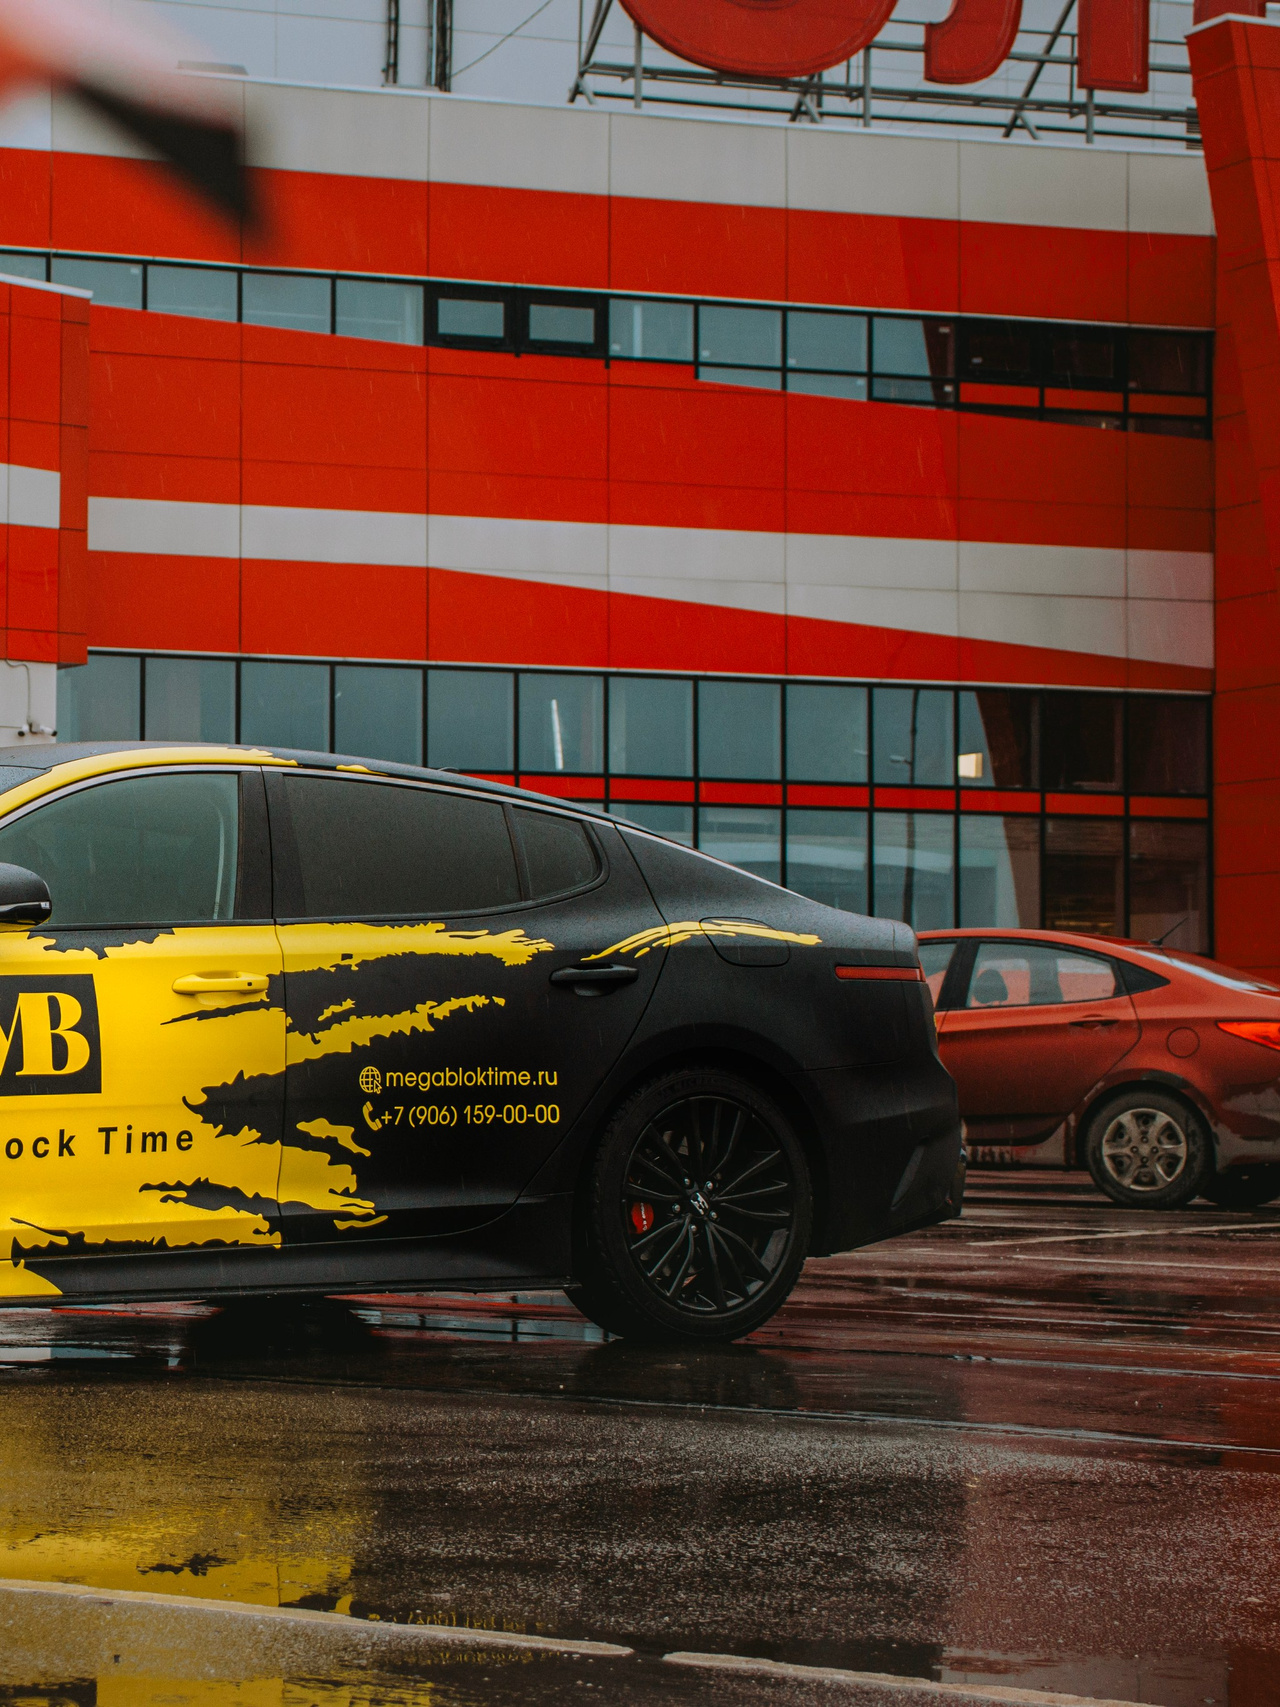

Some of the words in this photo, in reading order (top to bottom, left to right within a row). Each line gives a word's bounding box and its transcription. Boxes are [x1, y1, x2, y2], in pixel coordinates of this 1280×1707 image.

[386, 1067, 558, 1091] megabloktime.ru
[381, 1106, 404, 1125] +7
[408, 1105, 457, 1128] (906)
[463, 1104, 560, 1124] 159-00-00
[98, 1125, 194, 1154] Time
